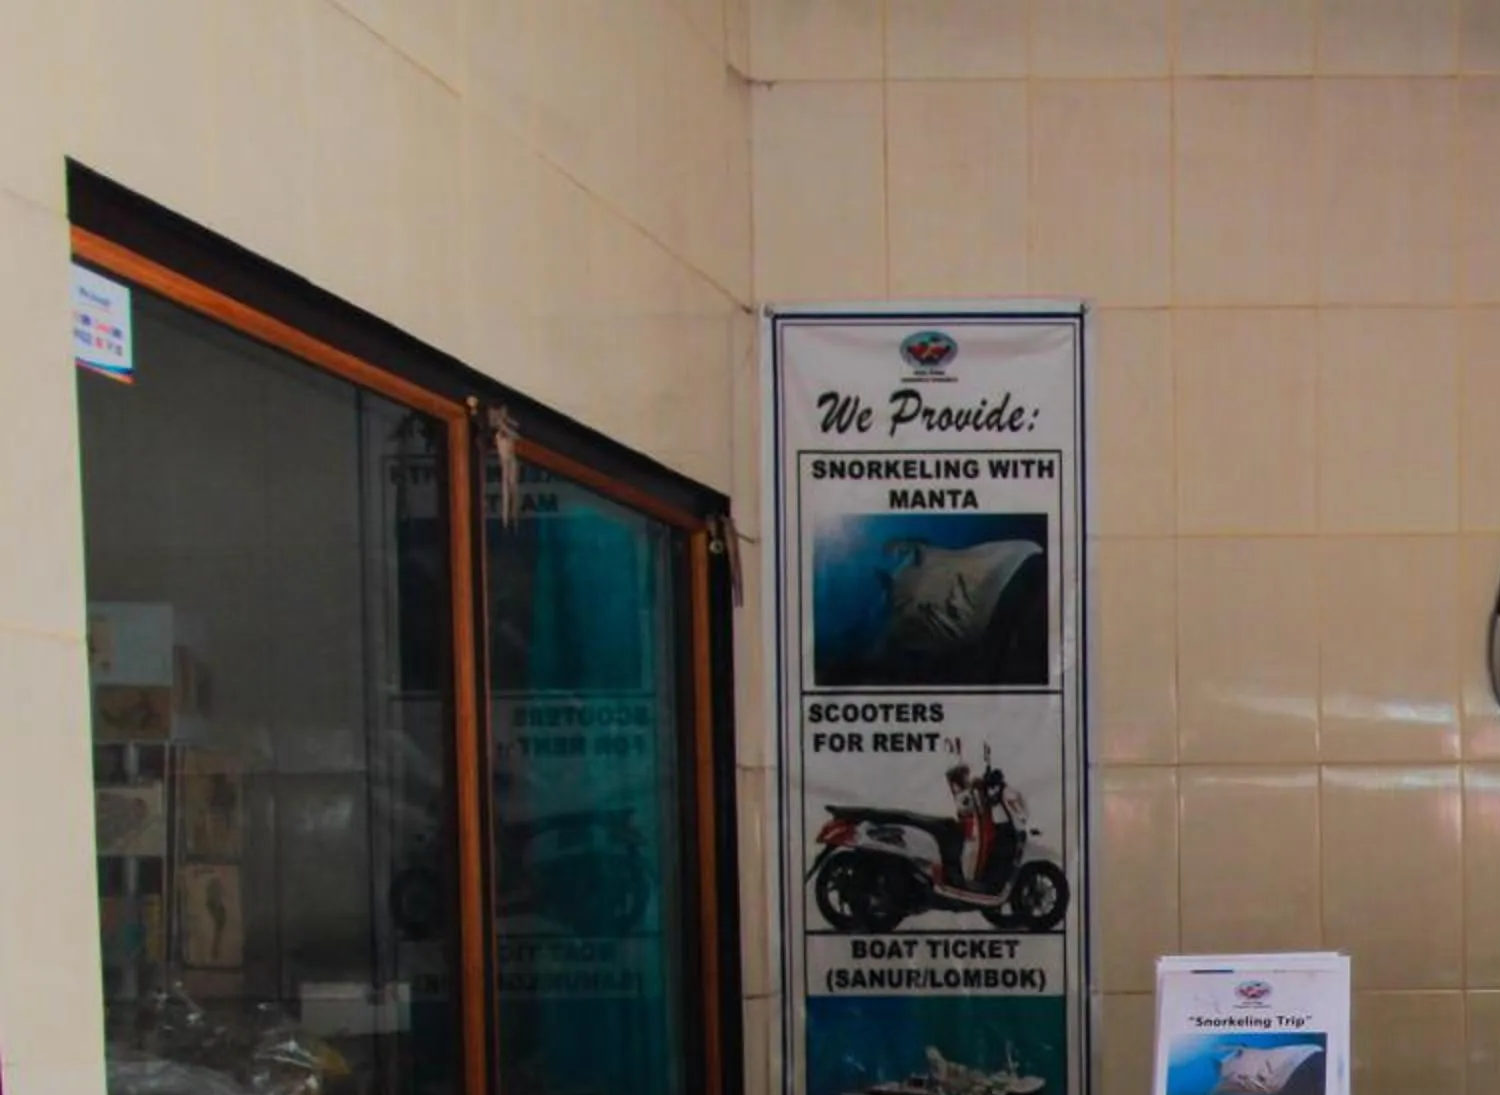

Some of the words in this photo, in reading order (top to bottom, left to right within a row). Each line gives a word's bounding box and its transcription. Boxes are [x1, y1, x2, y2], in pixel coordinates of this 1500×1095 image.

[816, 391, 873, 434] We
[889, 388, 1041, 437] Provide:
[811, 459, 981, 481] SNORKELING
[989, 459, 1056, 480] WITH
[888, 490, 980, 511] MANTA
[808, 703, 945, 724] SCOOTERS
[813, 733, 864, 754] FOR
[872, 733, 941, 754] RENT
[850, 939, 918, 961] BOAT
[926, 939, 1020, 960] TICKET
[825, 967, 1047, 993] (SANUR/LOMBOK)
